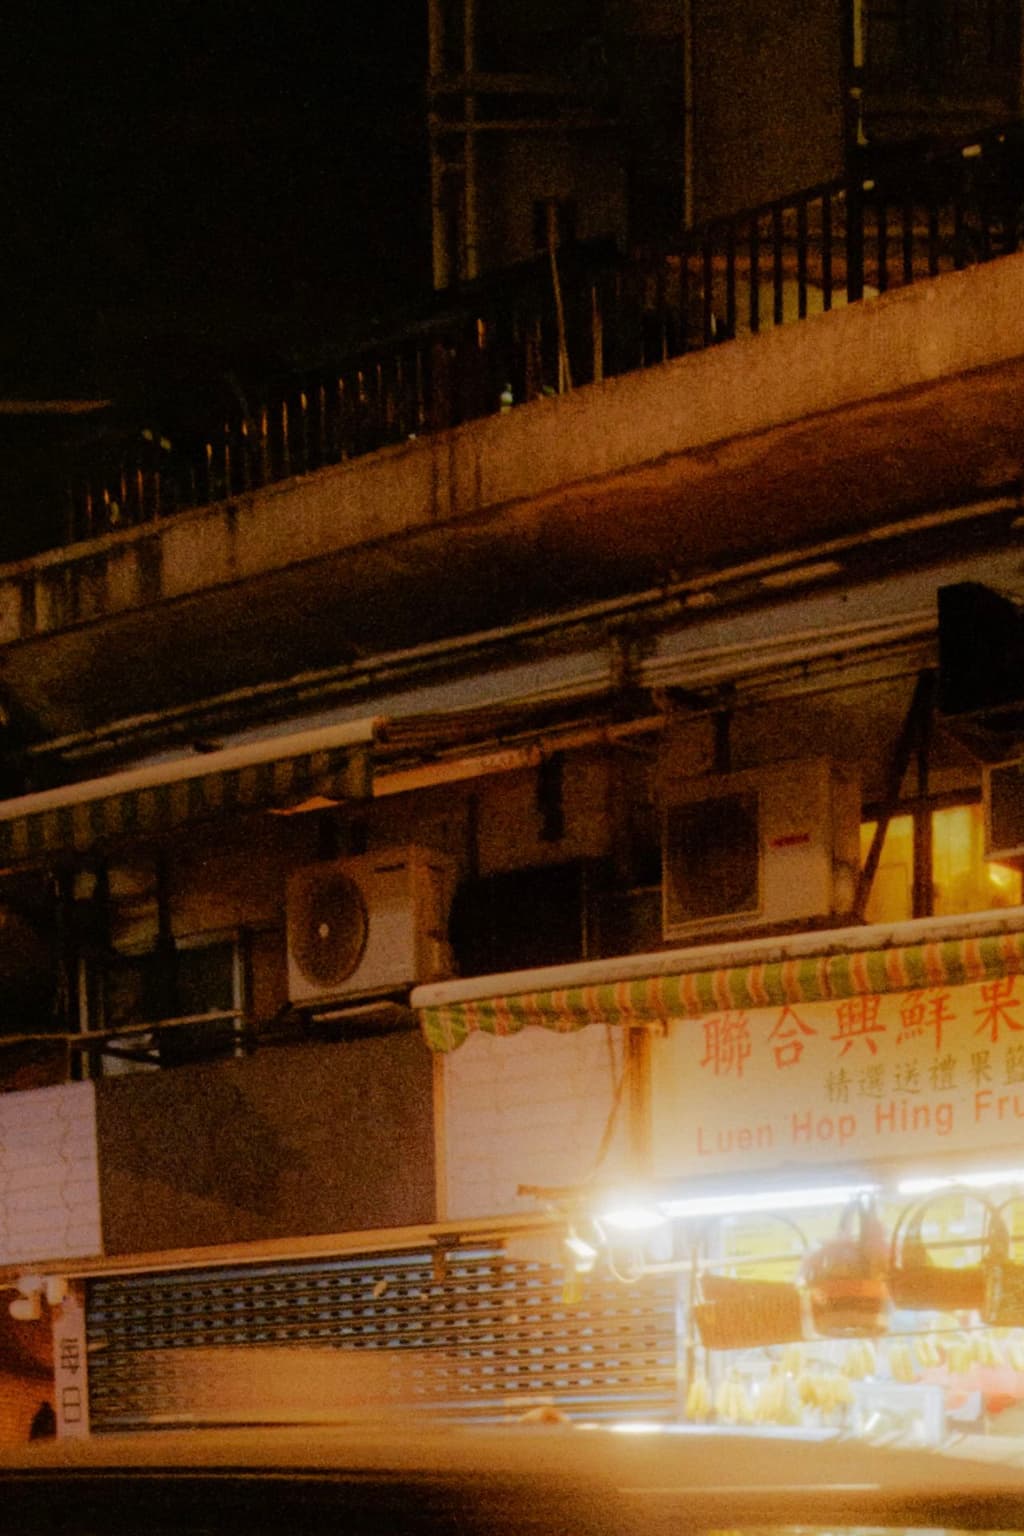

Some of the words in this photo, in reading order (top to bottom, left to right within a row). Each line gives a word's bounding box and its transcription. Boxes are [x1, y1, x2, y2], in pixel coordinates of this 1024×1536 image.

[697, 1115, 773, 1155] Luen
[792, 1109, 856, 1146] Hop
[875, 1098, 953, 1136] Hing
